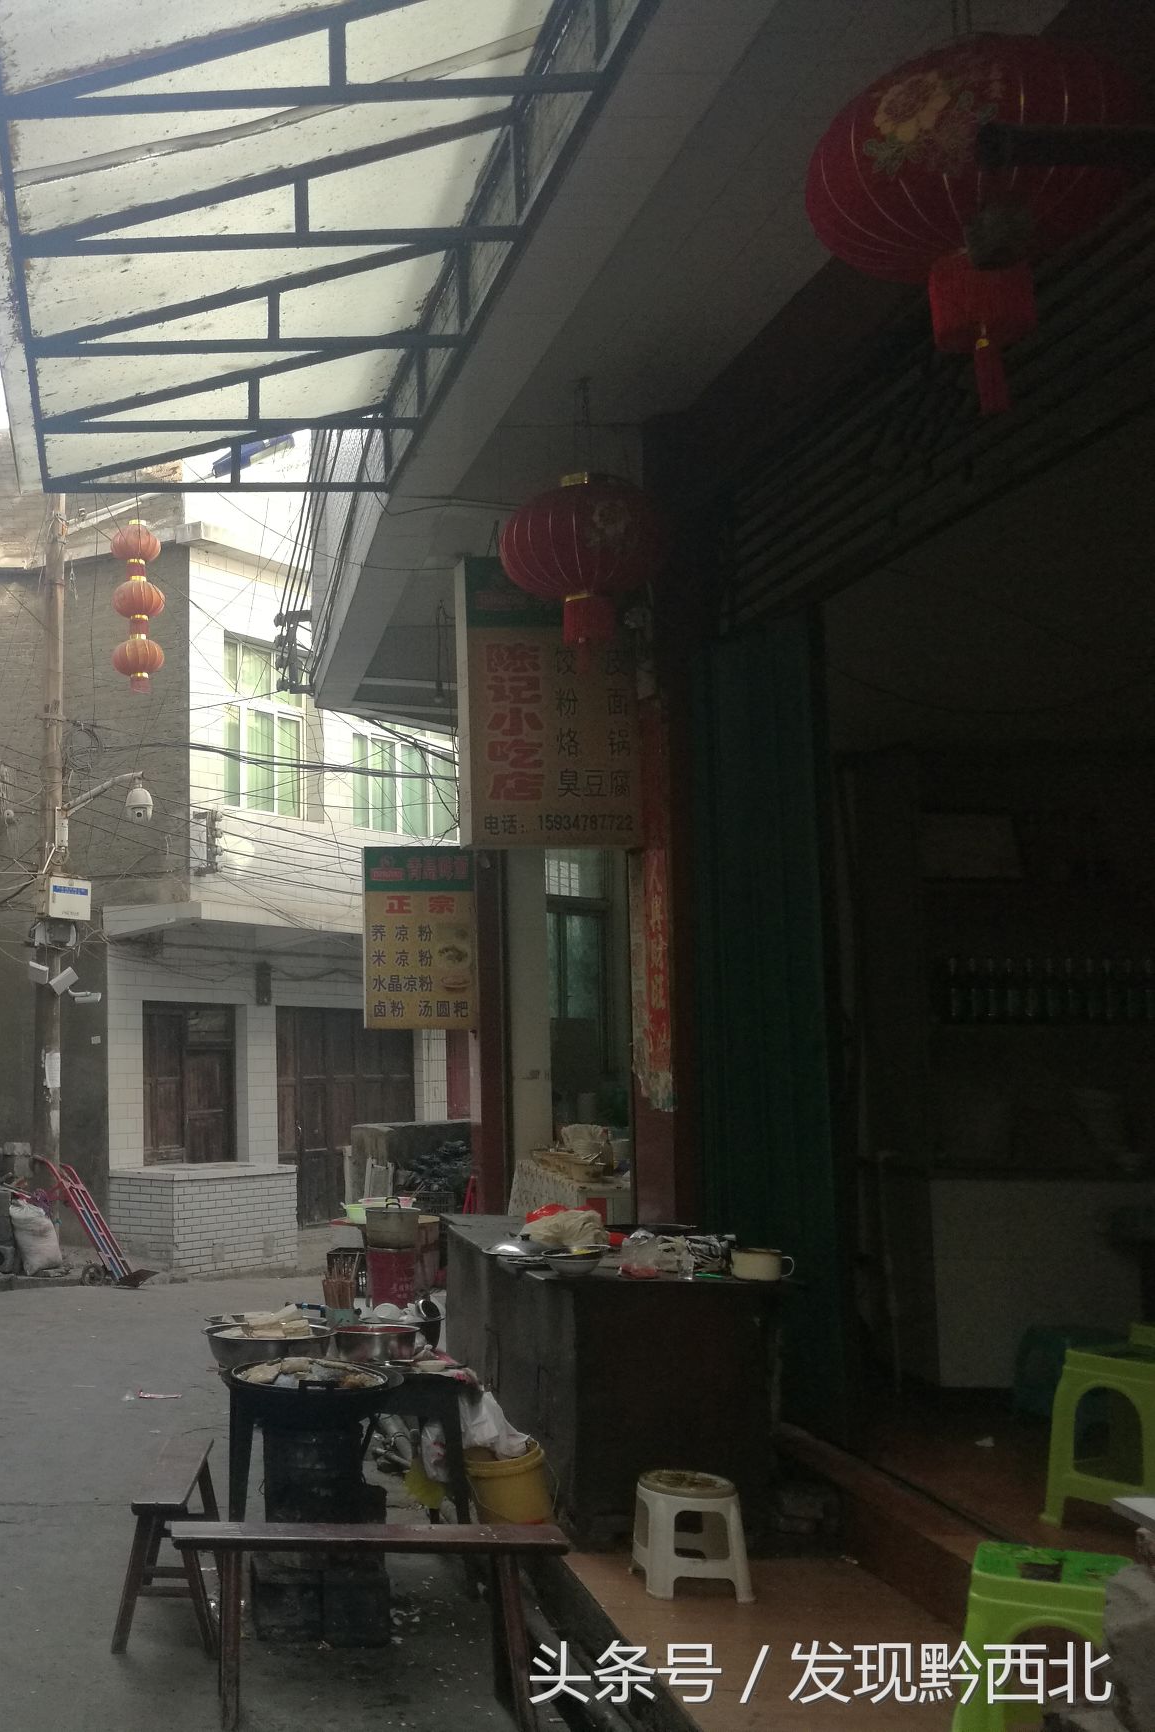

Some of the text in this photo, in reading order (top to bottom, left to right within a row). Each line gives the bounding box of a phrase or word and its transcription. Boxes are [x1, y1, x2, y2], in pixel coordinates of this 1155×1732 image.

[485, 642, 544, 801] 陈记小吃店
[557, 767, 632, 798] 臭豆腐
[385, 894, 456, 915] 正宗
[372, 949, 434, 968] 米凉粉
[372, 974, 434, 993] 水晶凉粉
